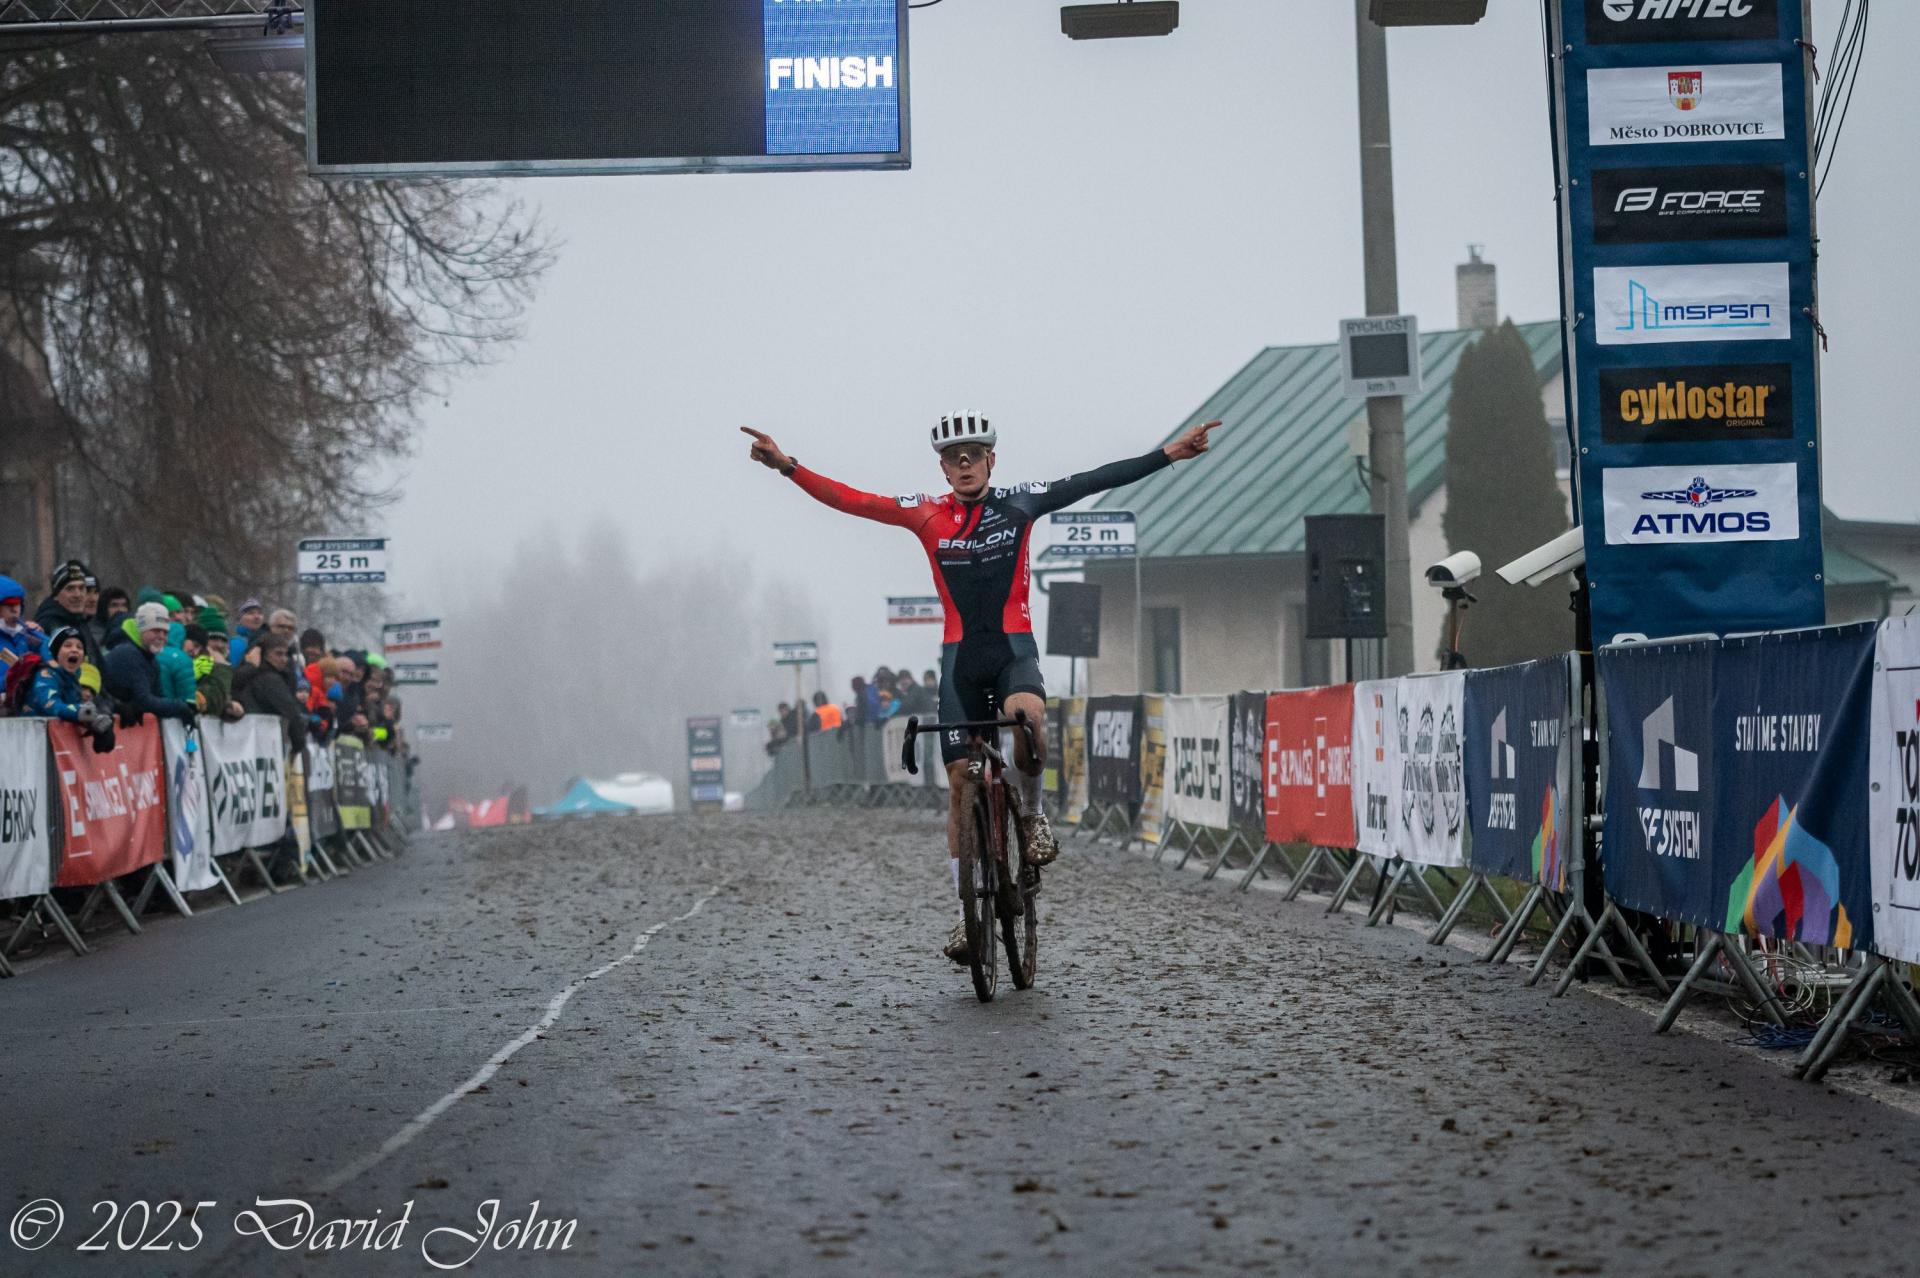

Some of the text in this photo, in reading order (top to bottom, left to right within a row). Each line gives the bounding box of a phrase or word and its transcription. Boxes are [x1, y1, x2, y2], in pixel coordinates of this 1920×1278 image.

[769, 55, 893, 89] FINISH
[1610, 123, 1764, 139] Město DOBROVICE
[1660, 190, 1765, 210] FORCE
[1620, 381, 1769, 425] cyklostar
[1726, 418, 1765, 427] ORIGINAL
[1067, 527, 1119, 541] 25 m
[1632, 511, 1770, 535] ATMOS
[938, 527, 1016, 549] BRILON
[316, 554, 369, 569] 25 m
[1781, 714, 1820, 751] STAVBY
[1637, 807, 1700, 859] SF SYSTEM
